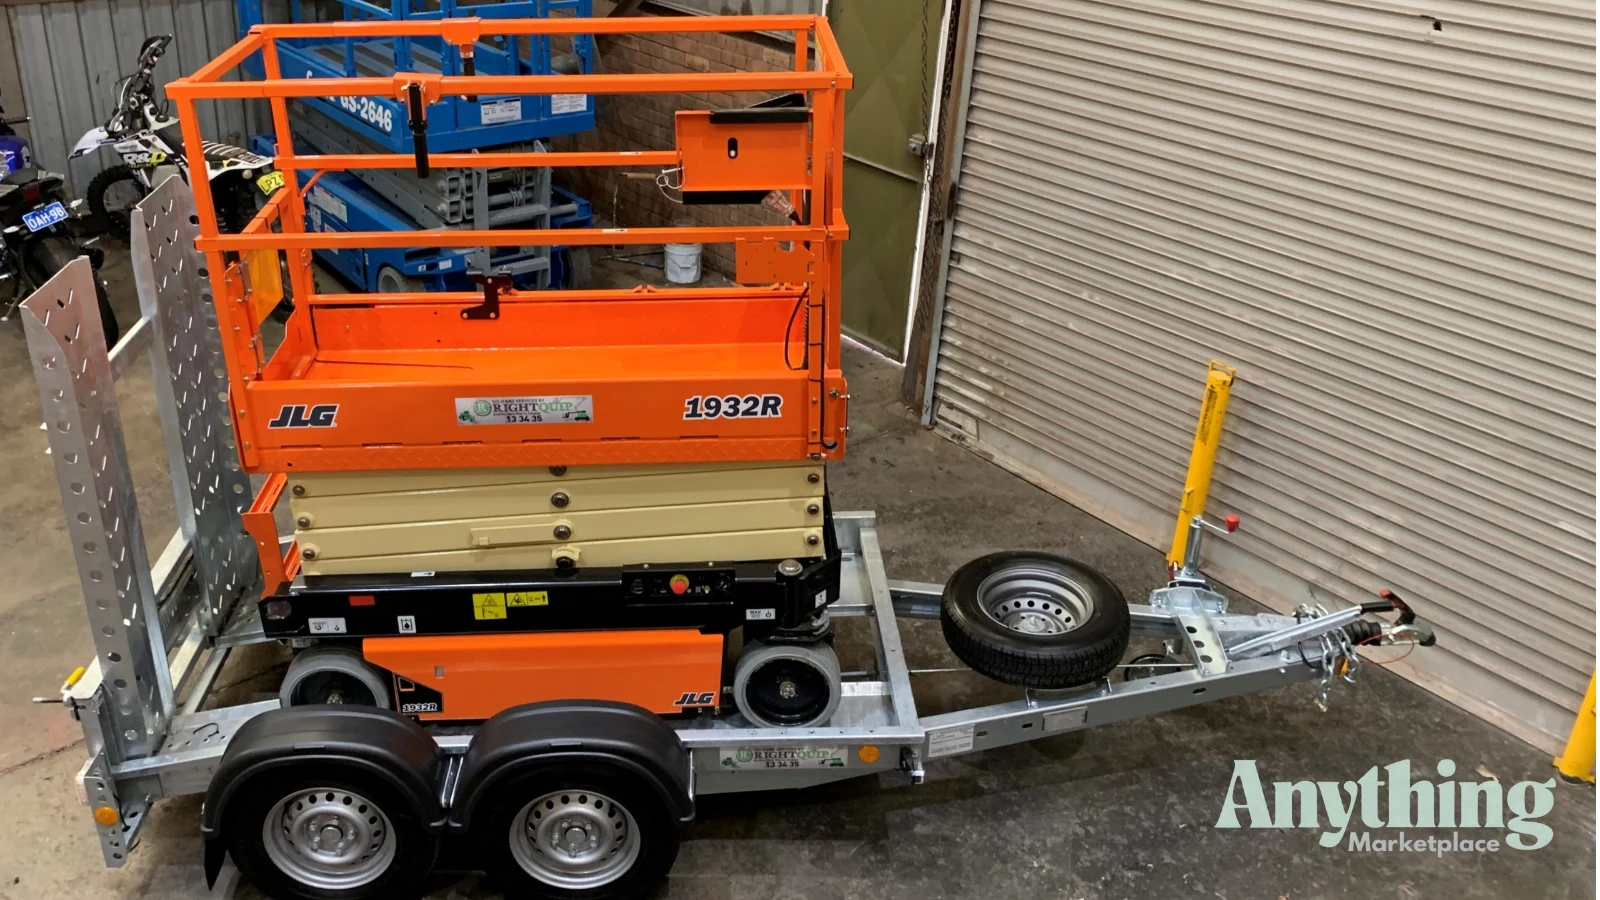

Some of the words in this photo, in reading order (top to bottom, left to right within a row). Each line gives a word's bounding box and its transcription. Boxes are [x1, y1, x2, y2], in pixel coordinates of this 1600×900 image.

[340, 96, 392, 132] GS-2646
[493, 402, 573, 413] RIGHTQUIP
[683, 394, 783, 420] 1932R
[268, 404, 339, 429] JLG
[507, 415, 517, 423] 13
[673, 691, 716, 706] JLG
[403, 703, 438, 712] 1932R
[755, 750, 829, 760] RIGHTQUIP
